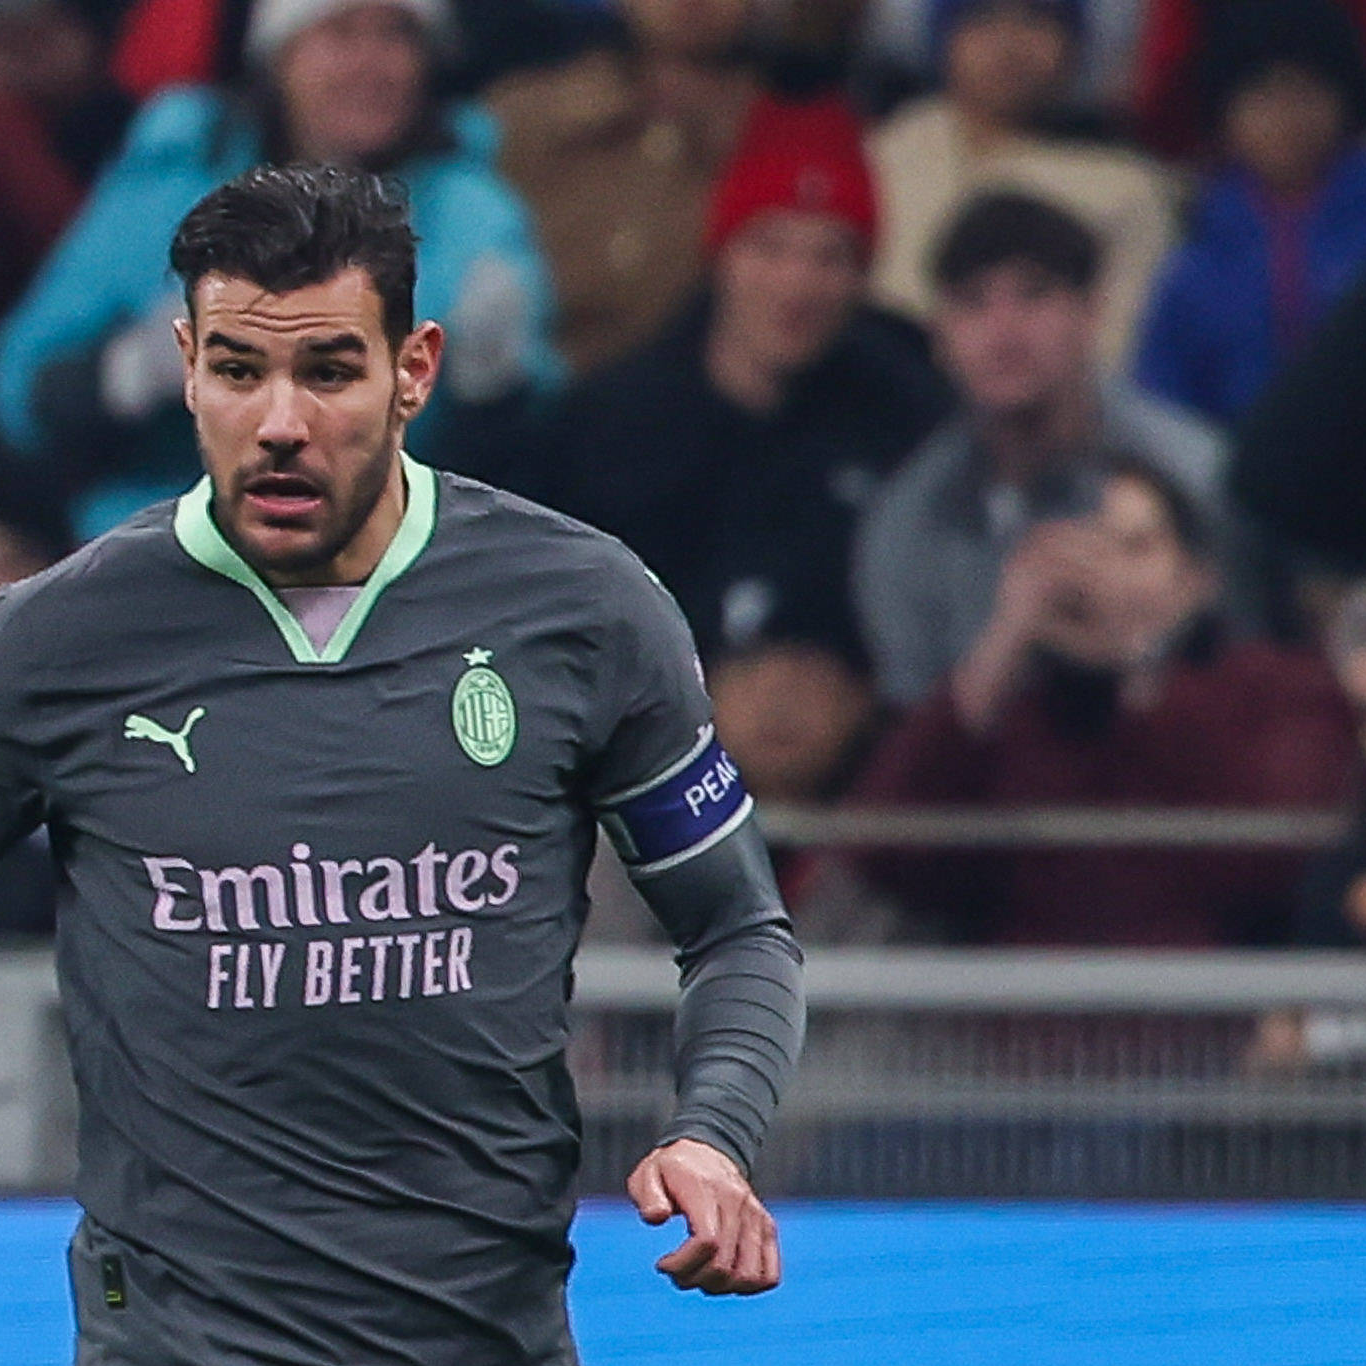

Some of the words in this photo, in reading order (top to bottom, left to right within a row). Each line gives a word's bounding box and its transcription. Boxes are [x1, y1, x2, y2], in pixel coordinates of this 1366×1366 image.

[142, 842, 520, 932] Emirates
[206, 943, 286, 1009] FLY
[304, 926, 473, 1006] BETTER
